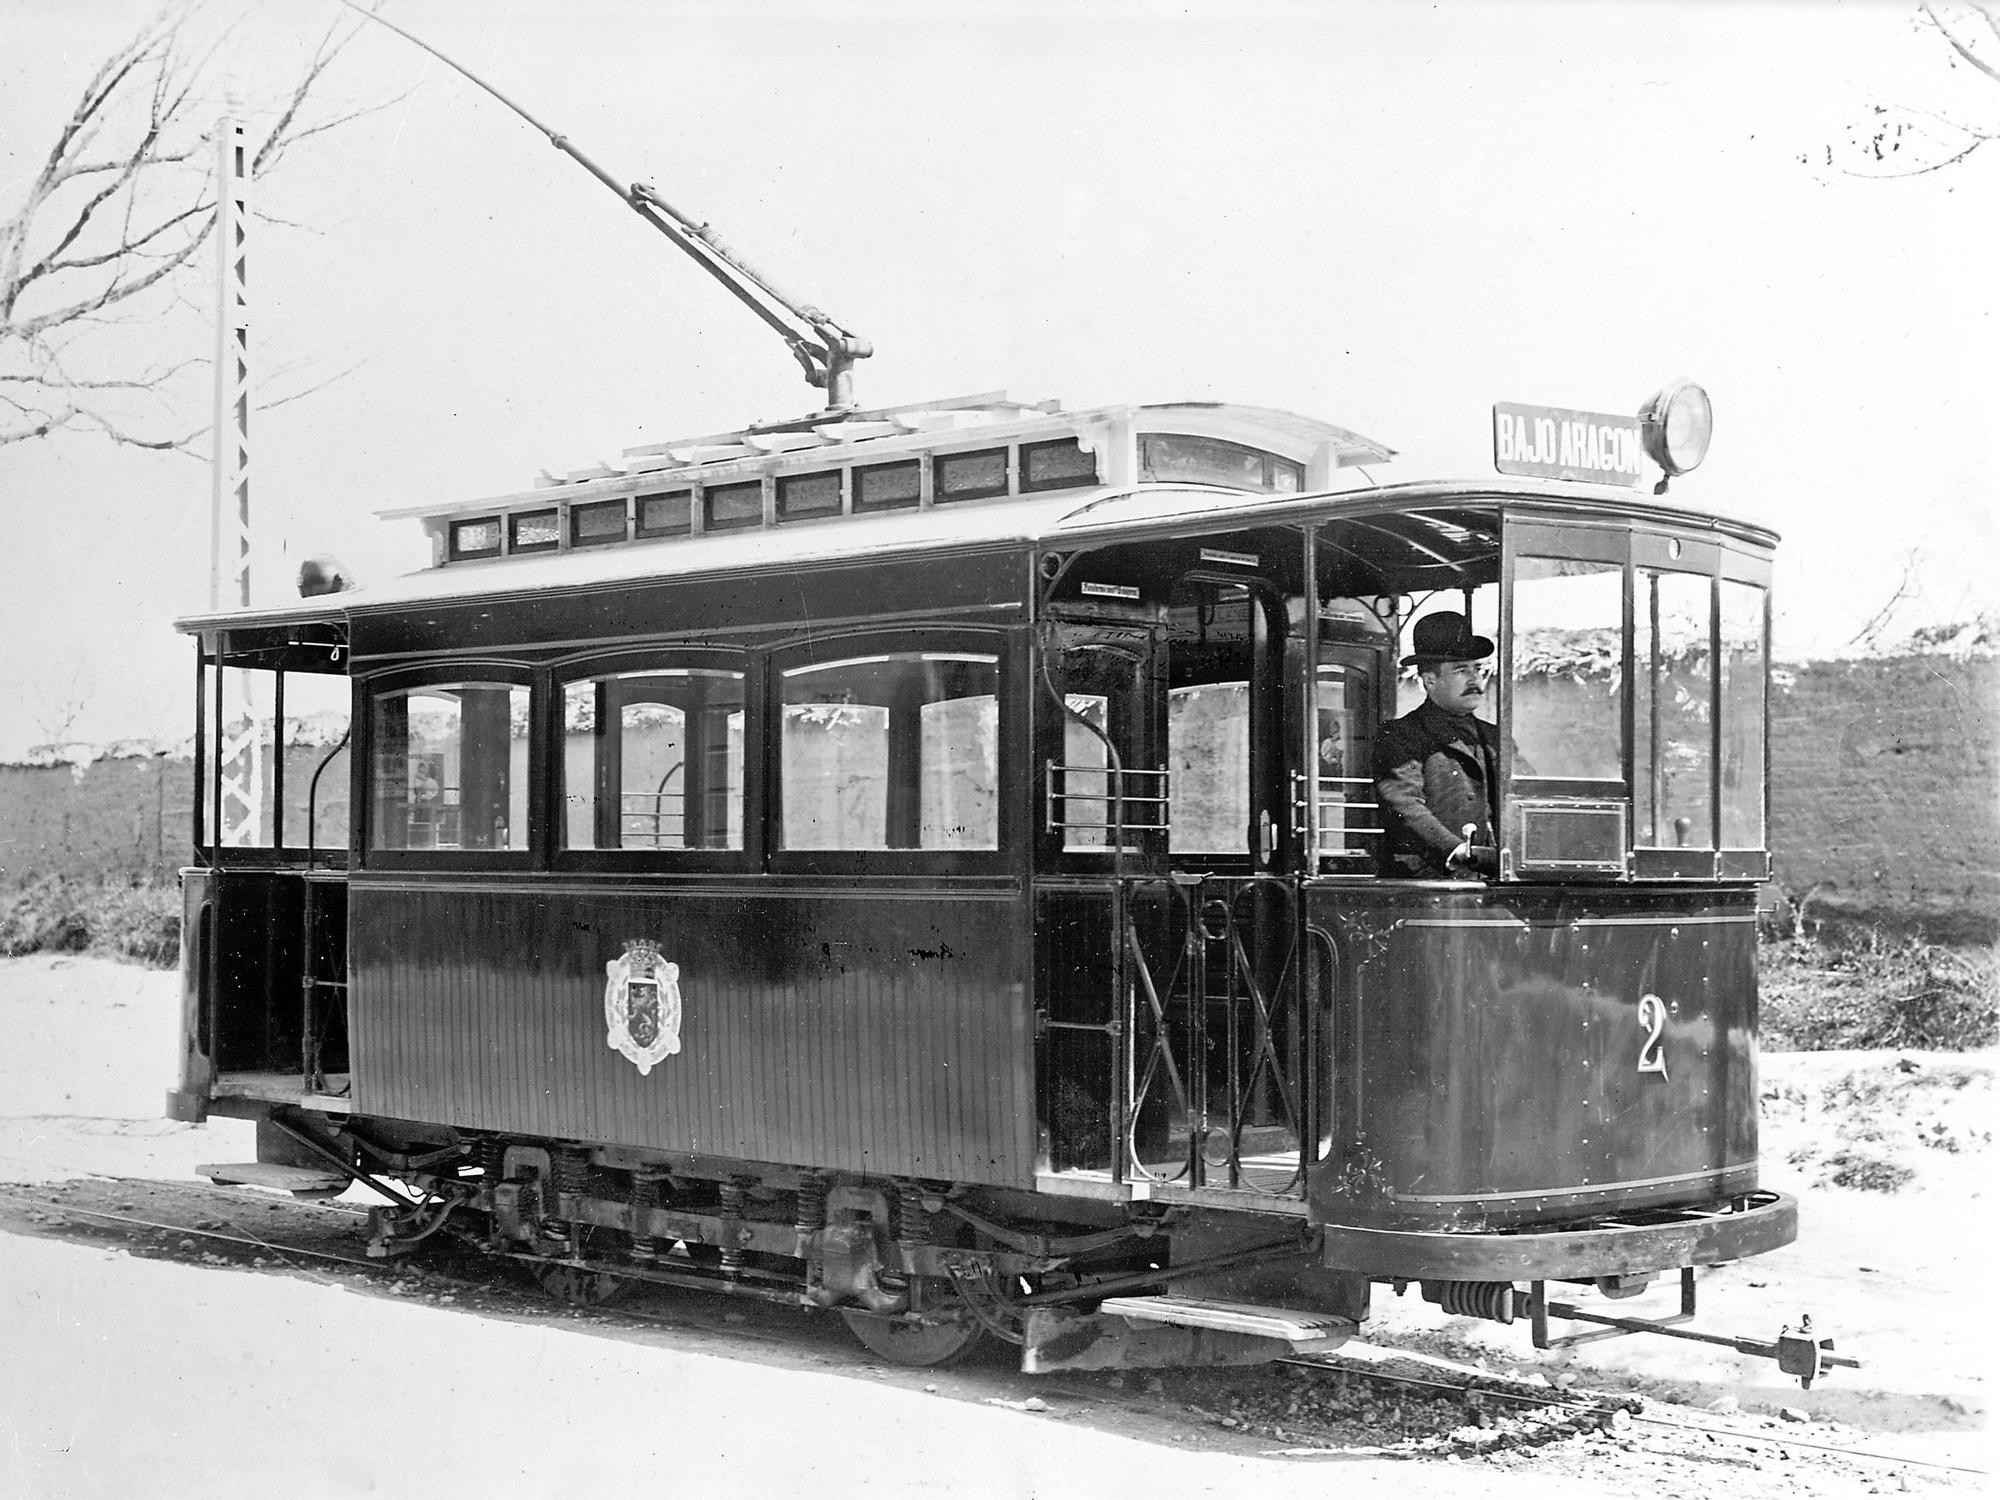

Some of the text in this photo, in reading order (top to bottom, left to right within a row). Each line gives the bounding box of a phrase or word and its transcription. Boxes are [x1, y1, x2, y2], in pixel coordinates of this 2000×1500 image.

[1497, 413, 1640, 475] BAJO ARAGON
[1637, 994, 1669, 1081] 2
